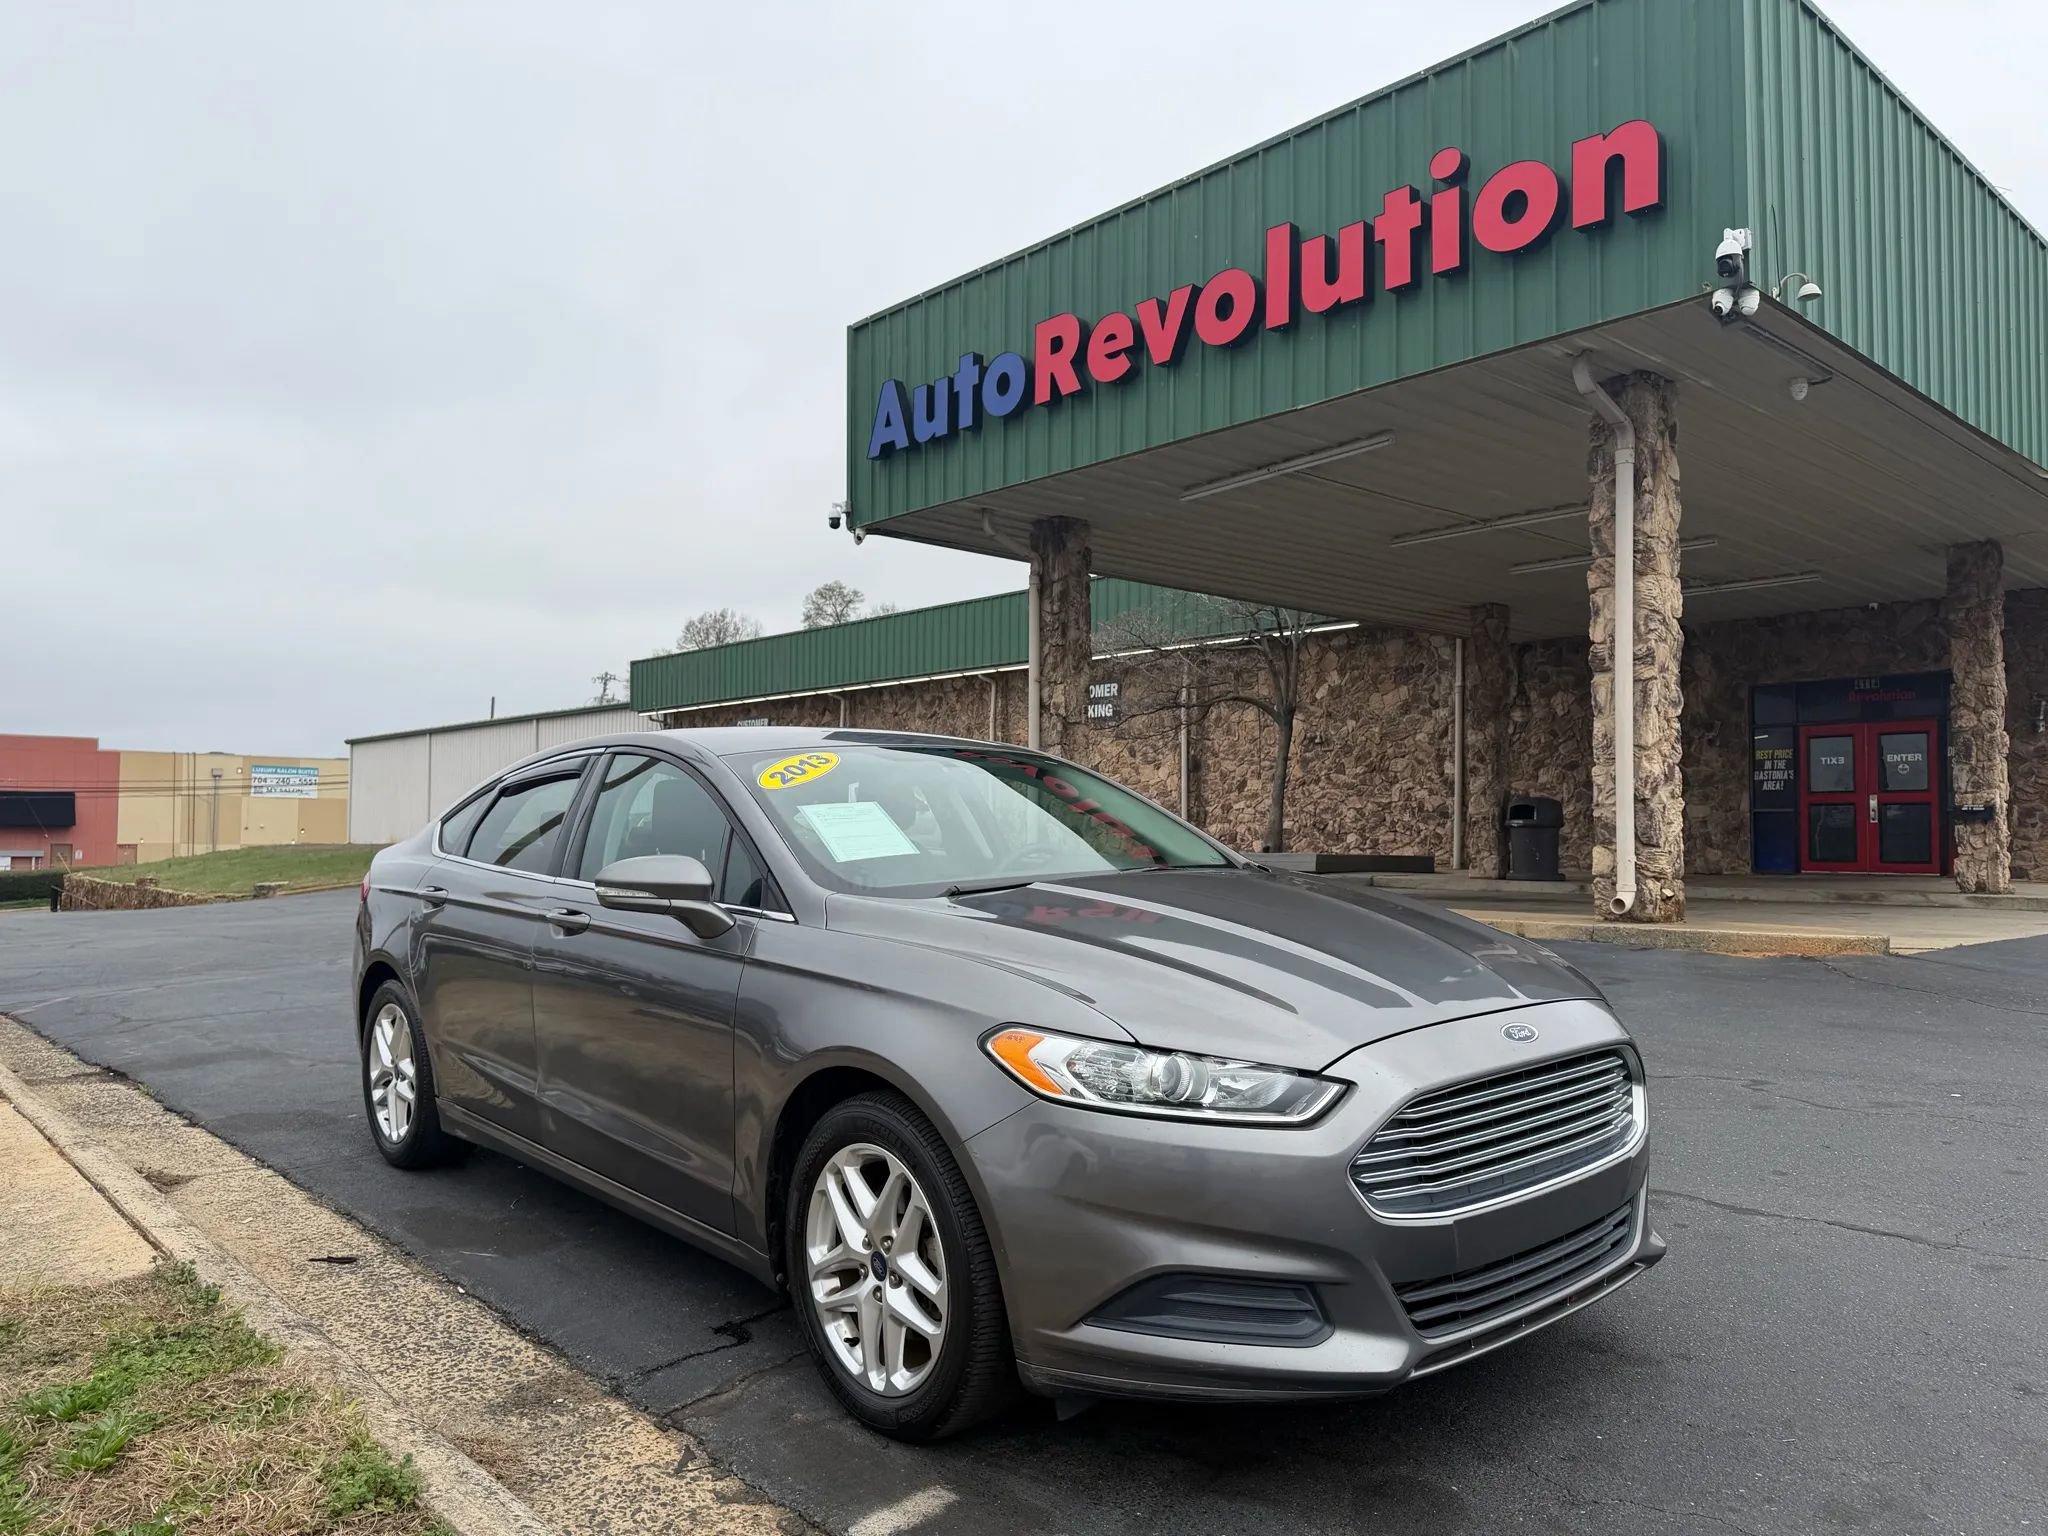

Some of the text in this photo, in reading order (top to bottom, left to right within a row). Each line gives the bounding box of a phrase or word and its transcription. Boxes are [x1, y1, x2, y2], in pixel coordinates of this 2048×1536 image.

[1089, 683, 1118, 698] OMER
[1088, 703, 1113, 718] KING
[1755, 748, 1793, 760] BEST PRICE
[1886, 753, 1922, 762] ENTER
[769, 754, 831, 785] 2013
[1764, 759, 1787, 770] IN THE
[1762, 779, 1784, 790] AREA!
[1509, 1027, 1532, 1039] Ford
